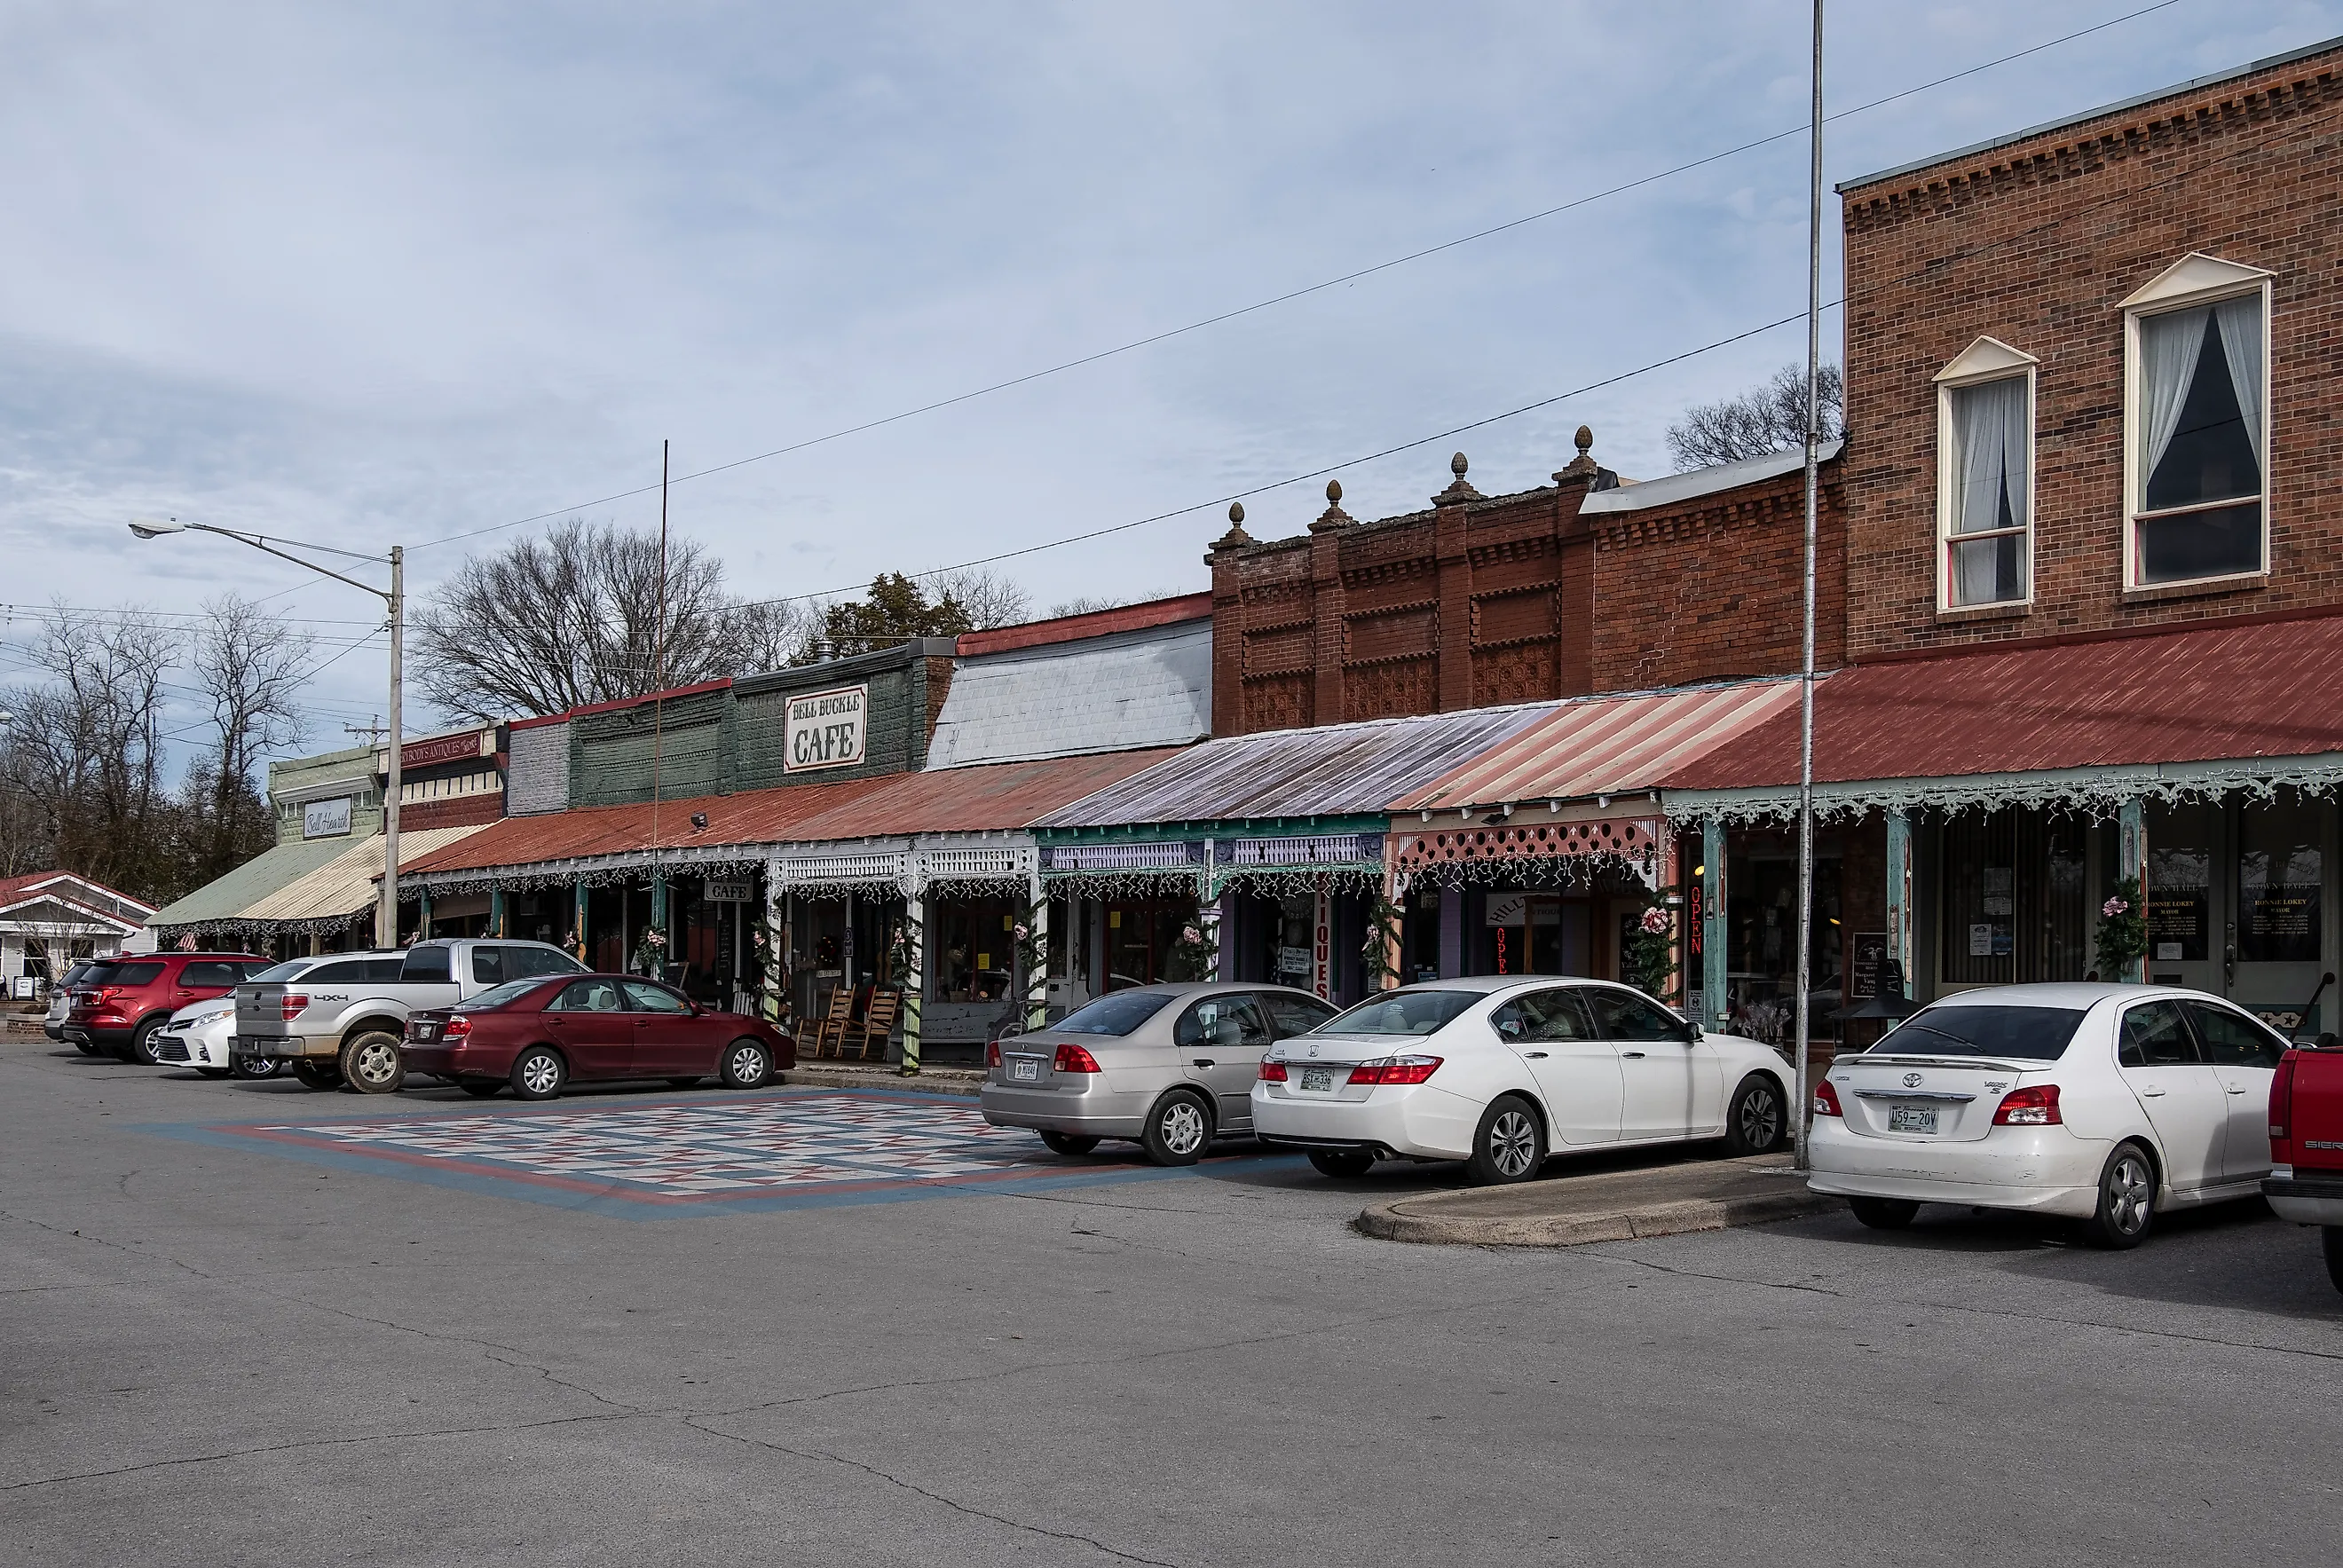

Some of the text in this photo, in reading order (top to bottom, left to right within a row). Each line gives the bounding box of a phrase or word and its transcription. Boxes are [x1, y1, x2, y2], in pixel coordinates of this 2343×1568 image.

[793, 694, 860, 721] BELL BUCKLE
[430, 740, 460, 758] ANTIQUES
[793, 721, 855, 764] CAFE
[306, 808, 349, 833] Bell Hearth
[712, 885, 747, 898] CAFE
[1692, 886, 1702, 954] OPEN
[1302, 1073, 1331, 1084] BSX 336
